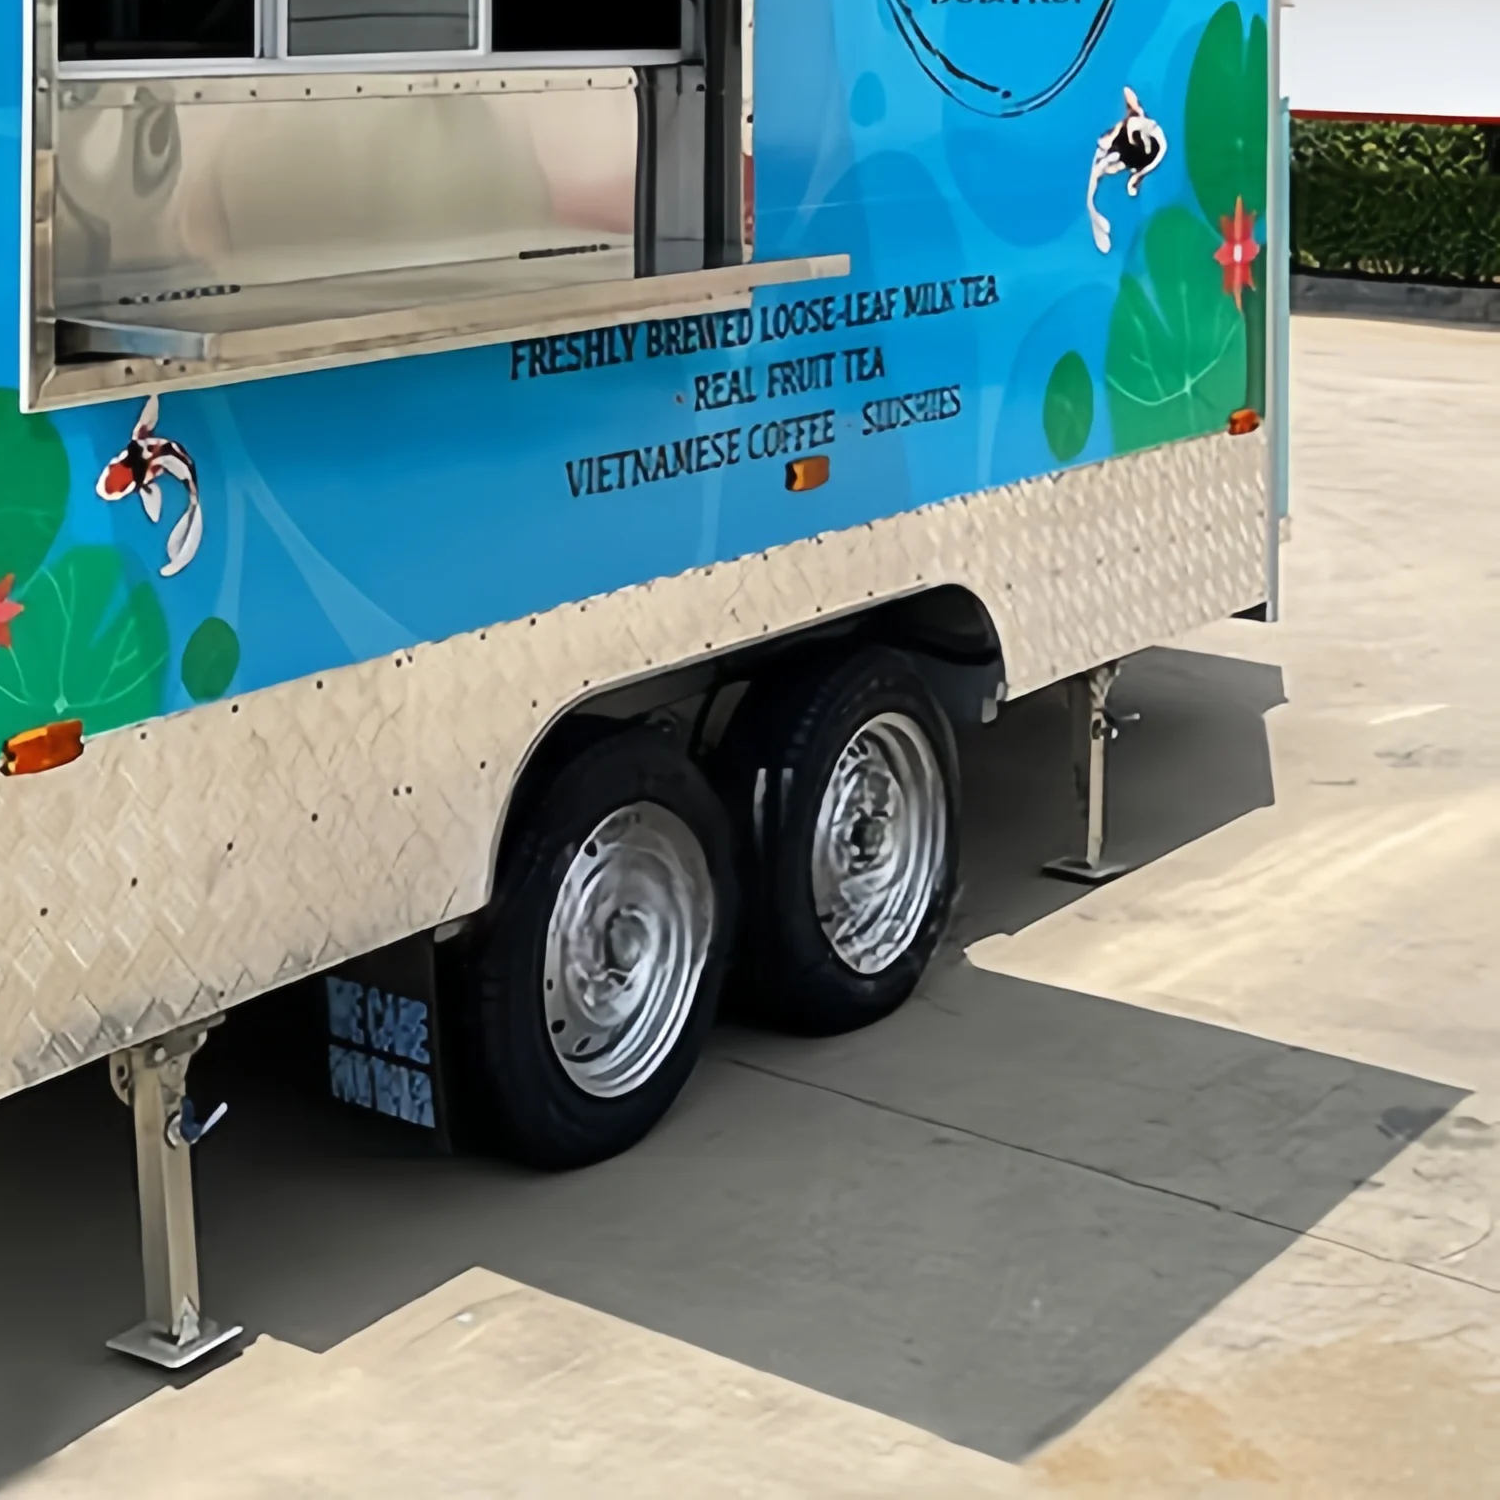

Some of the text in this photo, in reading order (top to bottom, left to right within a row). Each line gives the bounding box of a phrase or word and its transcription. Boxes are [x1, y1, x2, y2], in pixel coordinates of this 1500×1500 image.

[510, 275, 1000, 381] FRESHLY BREWED LOOSE-LEAF MILK TEA
[694, 346, 886, 413] REAL FRUIT TEA
[565, 427, 742, 498] VIETNAMESE
[747, 409, 836, 460] COFFEE
